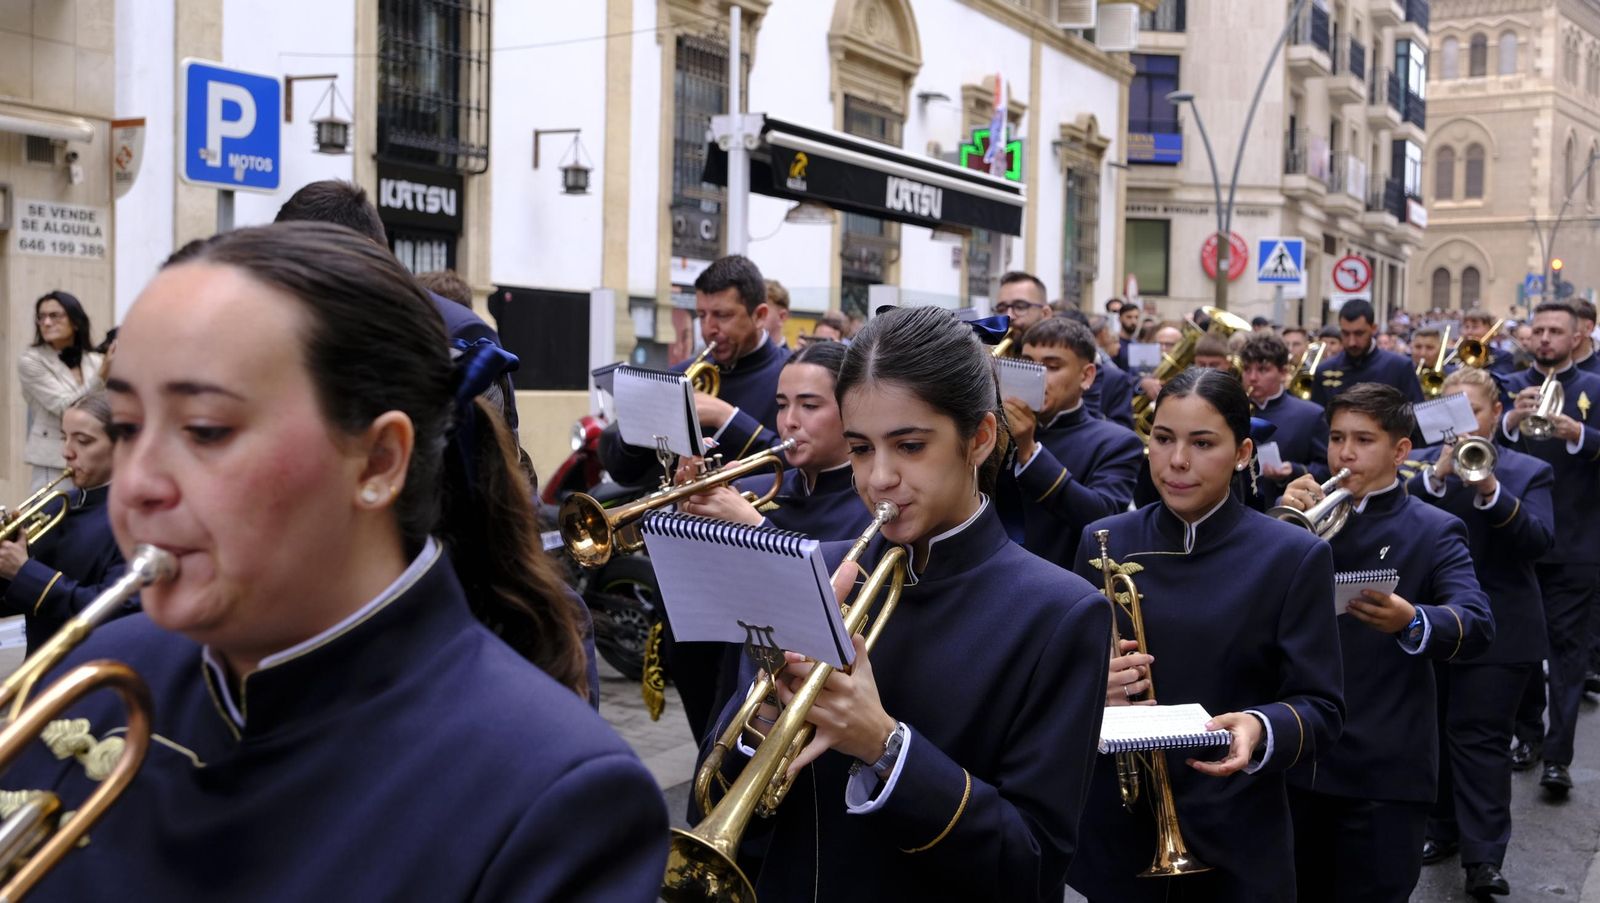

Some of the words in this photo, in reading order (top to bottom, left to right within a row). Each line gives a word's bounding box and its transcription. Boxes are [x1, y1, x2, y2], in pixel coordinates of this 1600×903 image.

[206, 80, 257, 168] P
[228, 152, 273, 173] MOTOS
[28, 204, 46, 217] SE
[50, 206, 97, 222] VENDE
[21, 218, 39, 232] SE
[44, 221, 103, 237] ALQUILA
[19, 238, 45, 251] 646
[51, 241, 76, 254] 199
